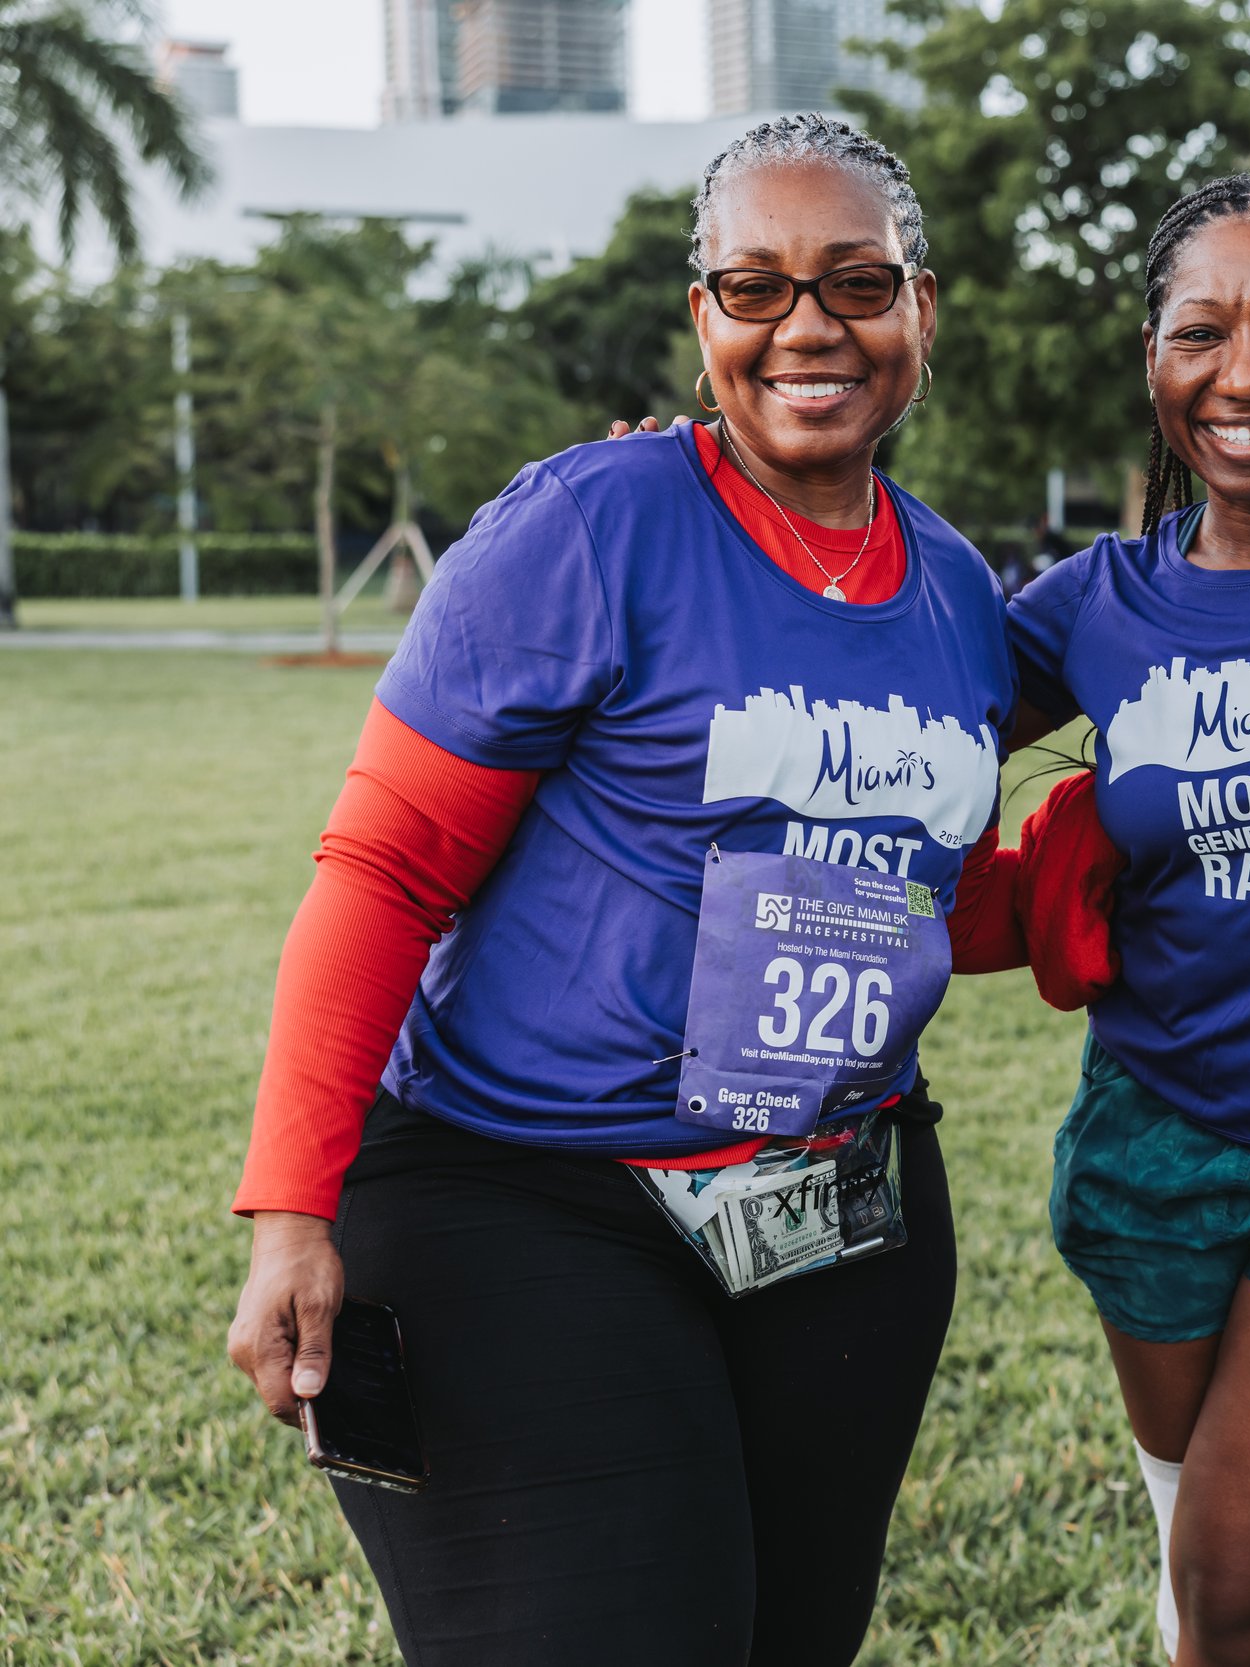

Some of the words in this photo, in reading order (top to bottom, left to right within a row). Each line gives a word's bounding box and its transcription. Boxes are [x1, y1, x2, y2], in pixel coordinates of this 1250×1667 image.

[807, 721, 936, 806] Miami's
[782, 821, 923, 878] MOST
[854, 877, 871, 888] Scan
[871, 880, 884, 890] the
[884, 883, 900, 893] code
[855, 887, 865, 896] for
[865, 890, 882, 900] your
[882, 892, 907, 904] results!
[797, 897, 824, 913] THE
[827, 901, 855, 917] GIVE
[858, 906, 891, 923] MIAMI
[893, 914, 909, 926] 5K
[795, 923, 909, 949] RACE+FESTIVAL
[777, 942, 803, 954] Hosted
[804, 943, 814, 956] by
[815, 946, 828, 957] The
[829, 948, 851, 960] Miami
[851, 951, 888, 965] Foundation
[757, 956, 893, 1057] 326
[741, 1047, 759, 1059] Visit
[760, 1049, 835, 1067] GiveMiamiDay.org
[836, 1057, 844, 1066] to
[844, 1057, 856, 1068] find
[856, 1060, 869, 1070] your
[718, 1087, 753, 1105] Gear
[755, 1091, 801, 1110] Check
[732, 1106, 770, 1132] 326
[772, 1163, 886, 1224] xfiny
